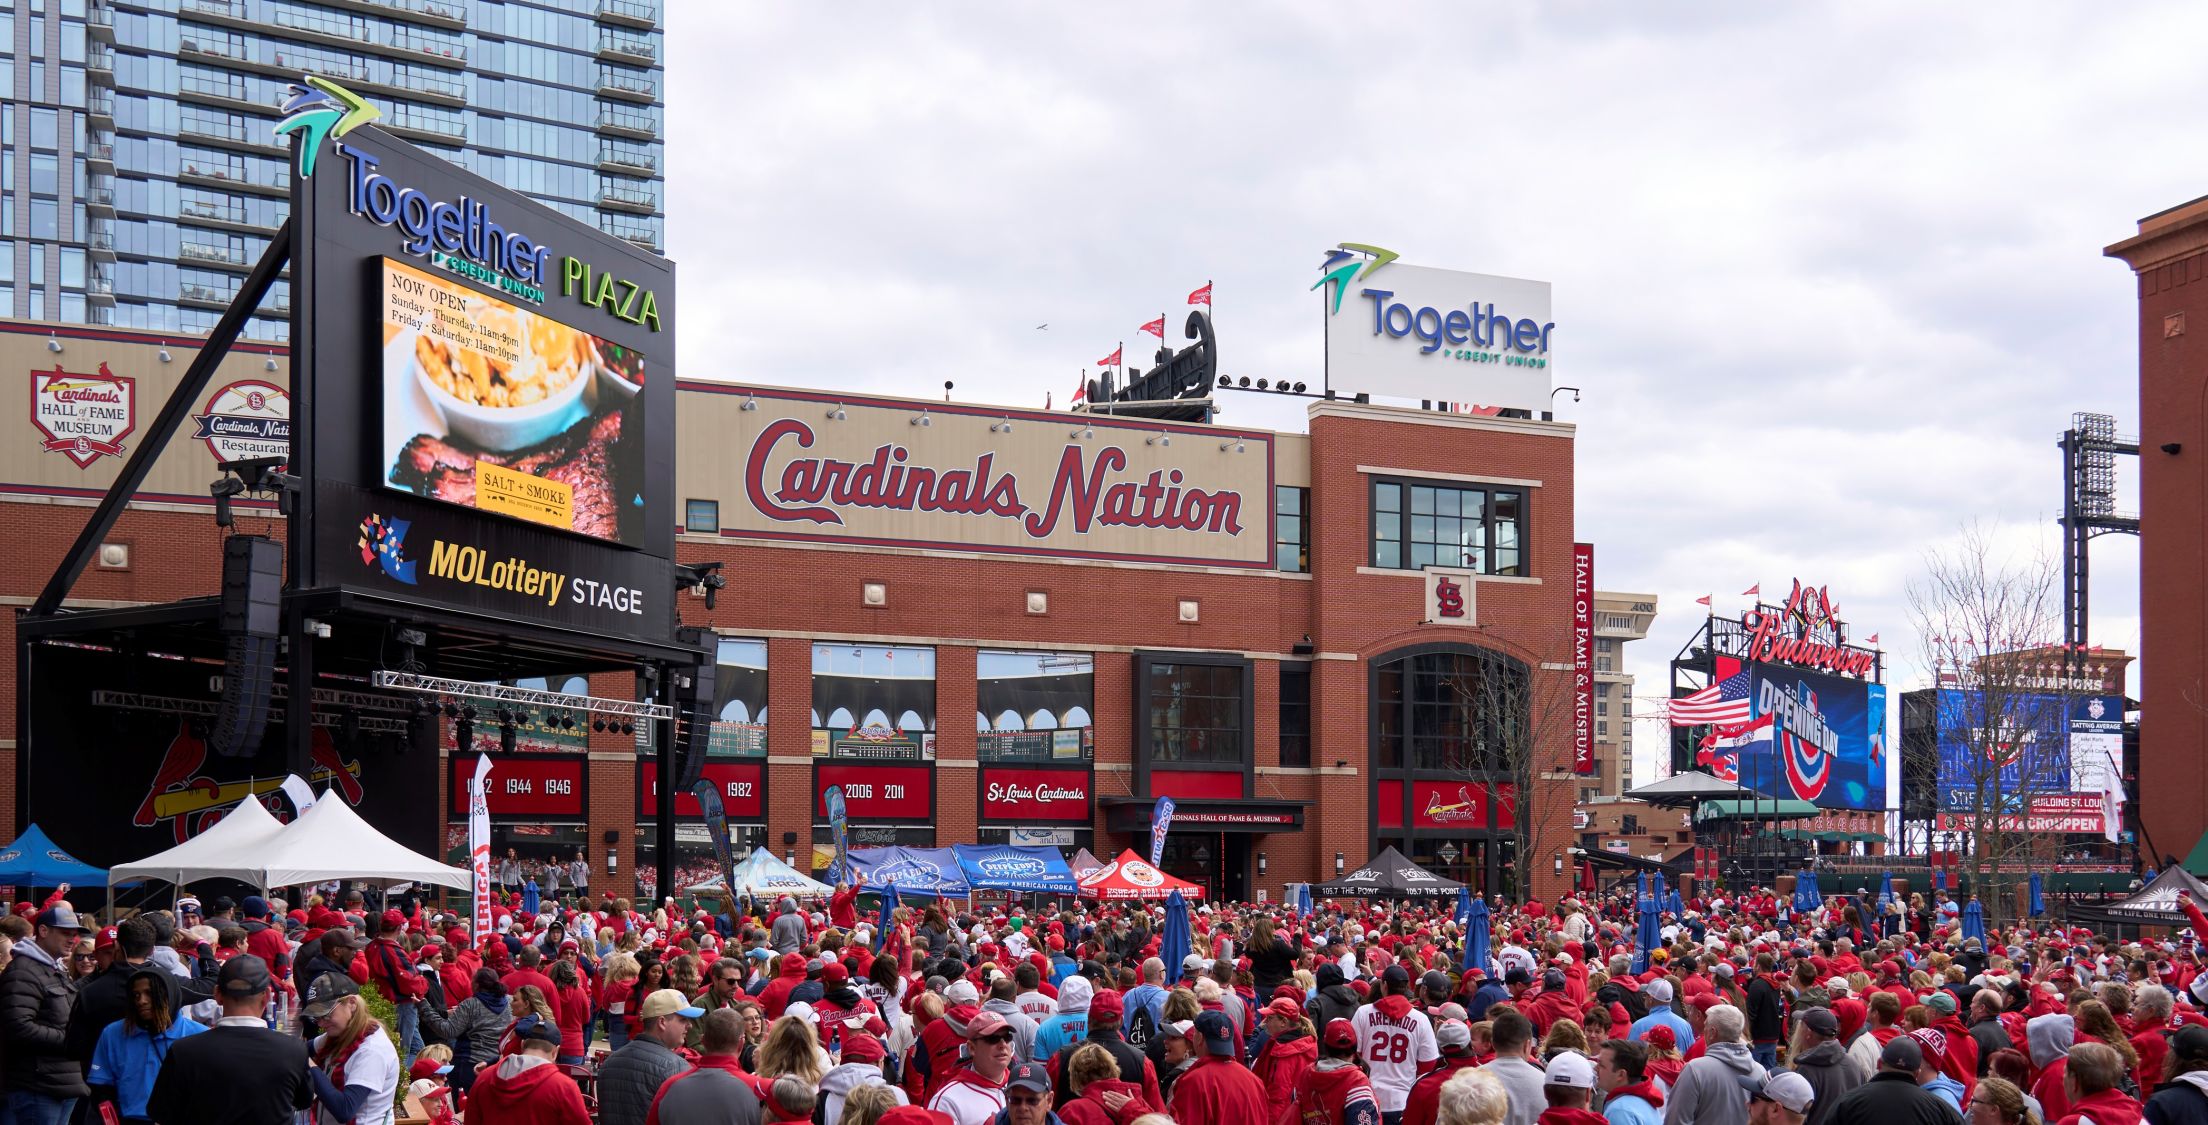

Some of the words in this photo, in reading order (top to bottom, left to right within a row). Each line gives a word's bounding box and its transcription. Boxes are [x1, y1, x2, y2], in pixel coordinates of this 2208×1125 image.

[335, 142, 552, 284] Together
[450, 257, 499, 286] CREDIT
[502, 276, 545, 304] UNION
[392, 273, 425, 297] NOW
[429, 288, 467, 313] OPEN
[563, 256, 662, 333] PLAZA
[391, 294, 425, 314] Sunday
[433, 307, 477, 334] Thursday:
[479, 325, 519, 348] 11am-9pm
[1361, 288, 1555, 353] Together
[391, 309, 423, 331] Friday
[431, 323, 474, 347] Saturday:
[475, 338, 519, 362] 11am-10pm
[1456, 349, 1502, 363] CREDIT
[1506, 355, 1546, 368] UNION
[54, 388, 121, 404] Cardinals
[42, 403, 77, 416] HALL
[79, 407, 87, 417] of
[90, 407, 125, 420] FAME
[54, 421, 113, 435] MUSEUM
[211, 416, 259, 434] Cardinals
[260, 421, 290, 437] Nati
[222, 440, 290, 454] Restaurant
[744, 417, 1029, 528] Cardinals
[1024, 443, 1244, 539] Nation
[484, 472, 515, 491] SALT
[527, 483, 566, 505] SMOKE
[428, 539, 565, 606] MOLottery
[571, 578, 643, 615] STAGE
[1576, 555, 1588, 597] HALL
[1576, 601, 1587, 622] OF
[1631, 602, 1653, 612] 400
[1576, 627, 1589, 669] FAME
[1744, 610, 1876, 676] Budweiser
[1576, 674, 1589, 687] &
[2015, 674, 2102, 690] CHAMPIONS
[1758, 678, 1821, 746] OPENING
[1822, 725, 1838, 755] DAY
[861, 727, 892, 736] BUSCH
[1576, 691, 1589, 762] MUSEUM
[506, 779, 532, 794] 1944
[545, 779, 571, 795] 1946
[727, 782, 752, 797] 1982
[845, 783, 873, 799] 2006
[884, 784, 904, 799] 2011
[1035, 783, 1085, 802] Cardinals
[2032, 798, 2069, 807] BUILDING
[2085, 799, 2102, 807] LOUI
[1171, 814, 1199, 822] RDINALS
[1200, 814, 1217, 822] HALL
[1432, 808, 1475, 824] Cardinals
[2027, 817, 2098, 831] CROUPPEN
[1039, 836, 1056, 844] and
[1056, 836, 1072, 845] You.
[880, 871, 902, 883] DEEP
[1011, 881, 1047, 889] AMERICAN
[1341, 887, 1354, 895] THE
[1358, 887, 1379, 895] POINT
[820, 1003, 869, 1022] Cardinals
[1021, 1002, 1050, 1014] MOLINA
[1062, 1021, 1085, 1033] SMITH
[1370, 1031, 1409, 1064] 28
